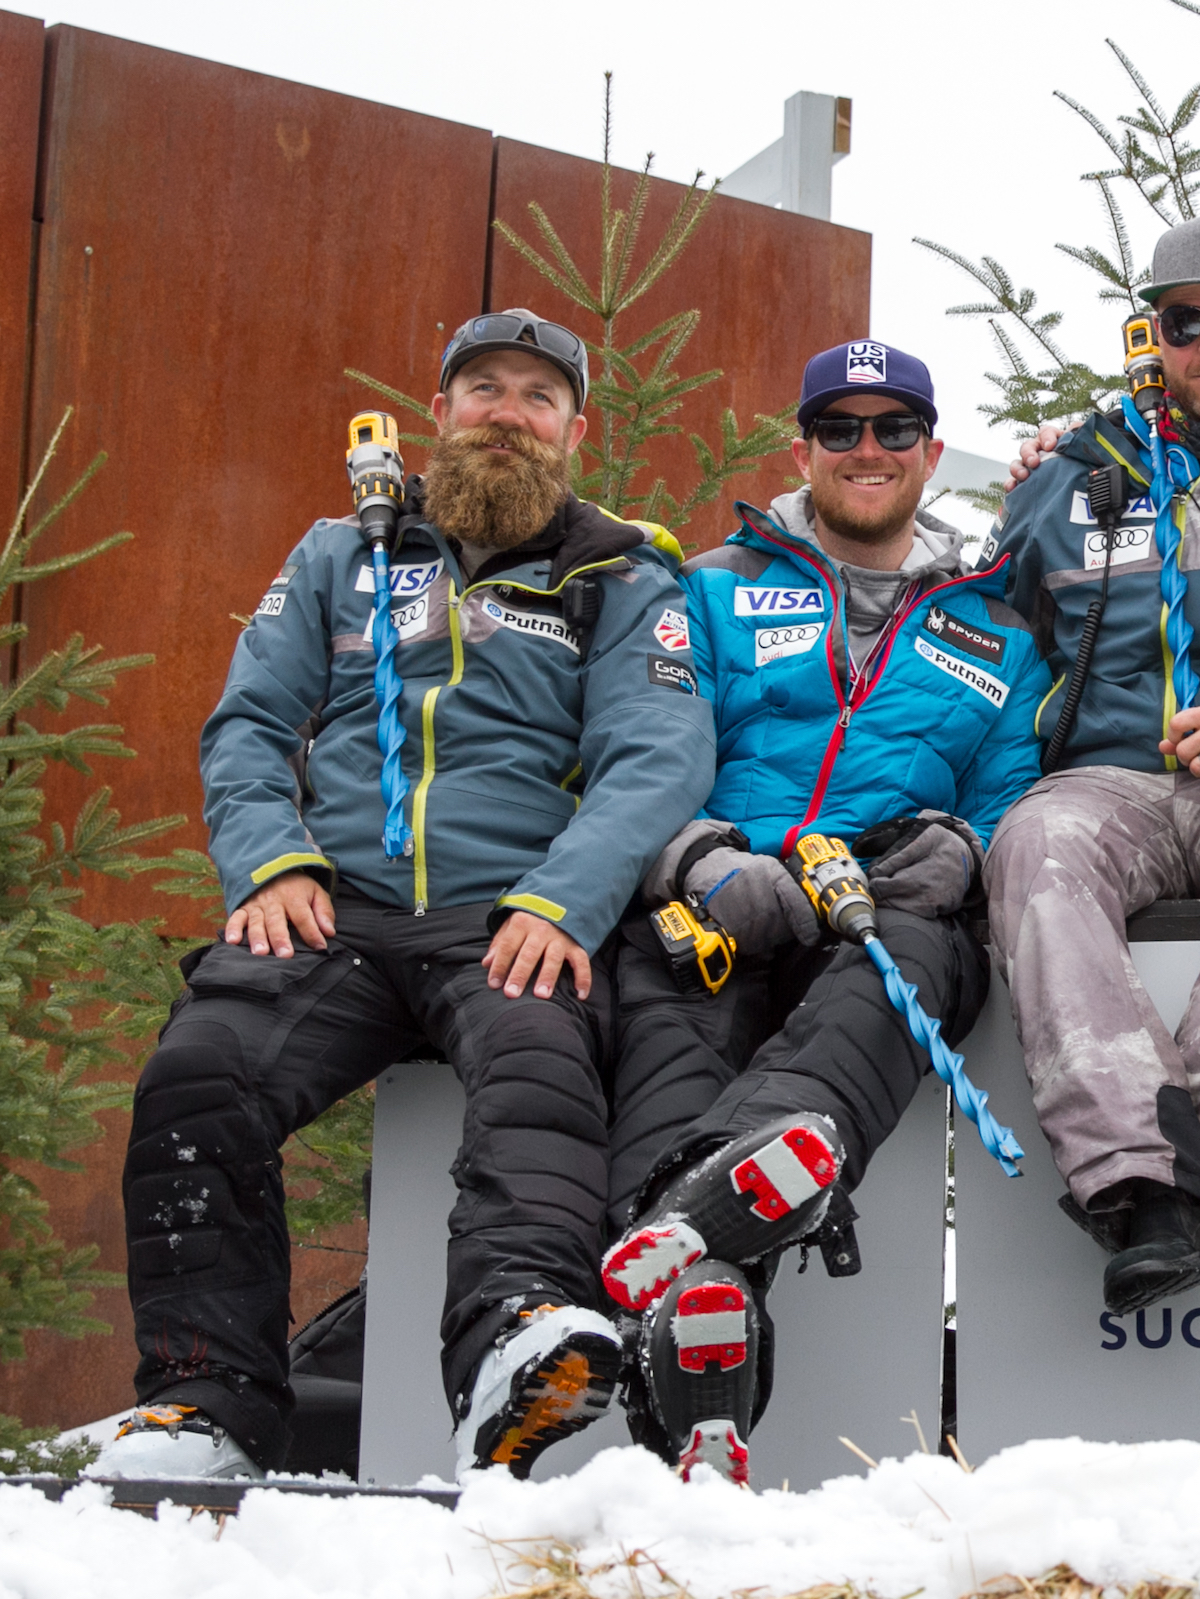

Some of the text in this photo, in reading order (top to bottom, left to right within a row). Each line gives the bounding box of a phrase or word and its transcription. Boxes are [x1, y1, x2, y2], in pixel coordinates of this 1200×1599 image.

[850, 344, 883, 357] US
[740, 590, 823, 611] VISA
[666, 612, 685, 625] US
[947, 620, 1001, 652] SPYDER
[760, 650, 784, 664] Audi
[934, 653, 1003, 702] Putnam
